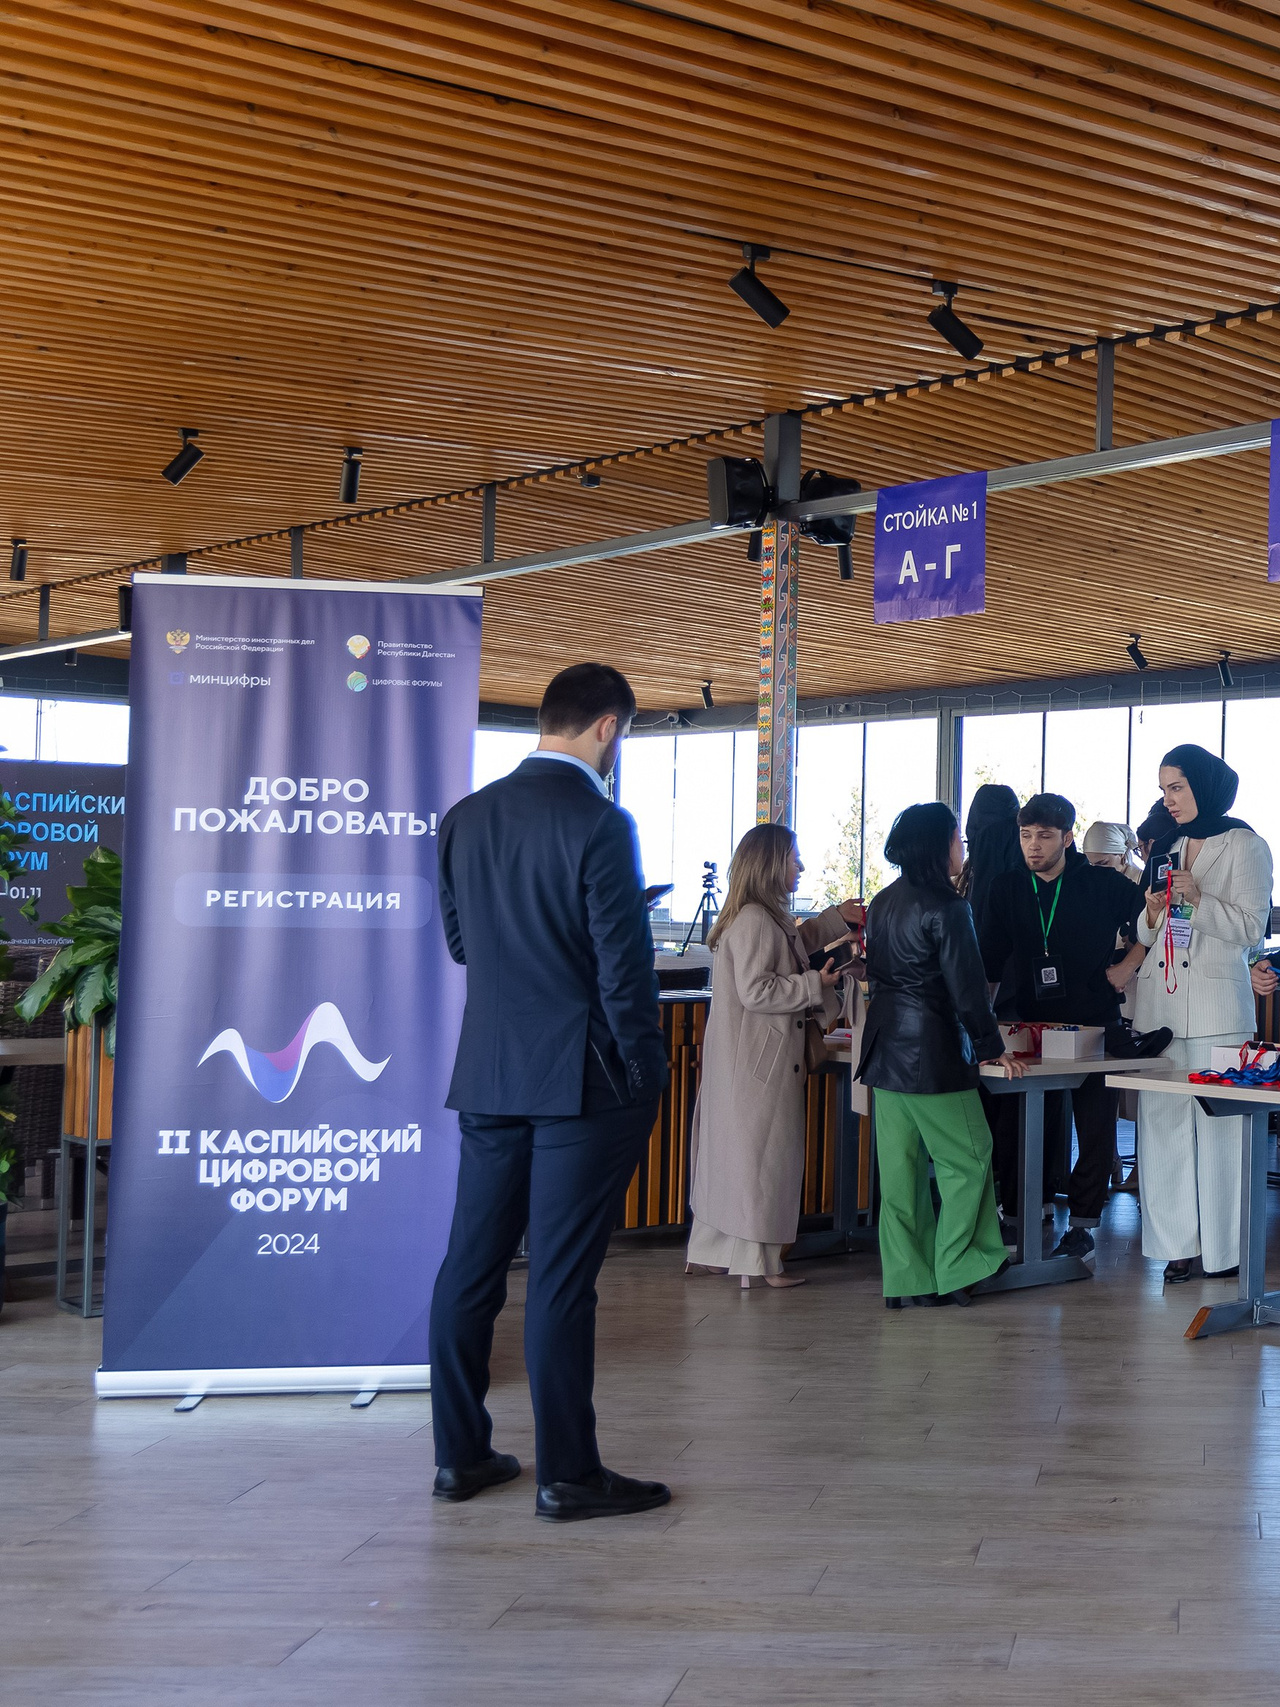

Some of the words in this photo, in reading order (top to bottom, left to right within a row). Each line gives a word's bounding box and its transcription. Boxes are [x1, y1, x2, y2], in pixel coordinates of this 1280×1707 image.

[883, 504, 949, 532] СТОЙКА
[952, 503, 969, 523] №
[972, 501, 977, 519] 1
[898, 550, 919, 585] А
[925, 563, 937, 571] -
[945, 544, 961, 579] Г
[195, 634, 251, 643] Министерство
[251, 637, 300, 645] иностранных
[195, 643, 240, 651] Российской
[240, 644, 284, 653] Федерации
[377, 640, 433, 649] Правительство
[377, 649, 421, 658] Республики
[422, 650, 456, 658] Дагестан
[189, 673, 271, 688] минцифры
[372, 678, 411, 686] ЦИФРОВЫЕ
[244, 776, 370, 805] ДОБРО
[174, 807, 438, 837] ПОЖАЛОВАТЬ!
[206, 889, 401, 912] РЕГИСТРАЦИЯ
[158, 1130, 190, 1155] II
[200, 1124, 422, 1154] КАСПИЙСКИЙ
[199, 1153, 380, 1187] ЦИФРОВОЙ
[230, 1187, 348, 1212] ФОРУМ
[257, 1233, 320, 1255] 2024
